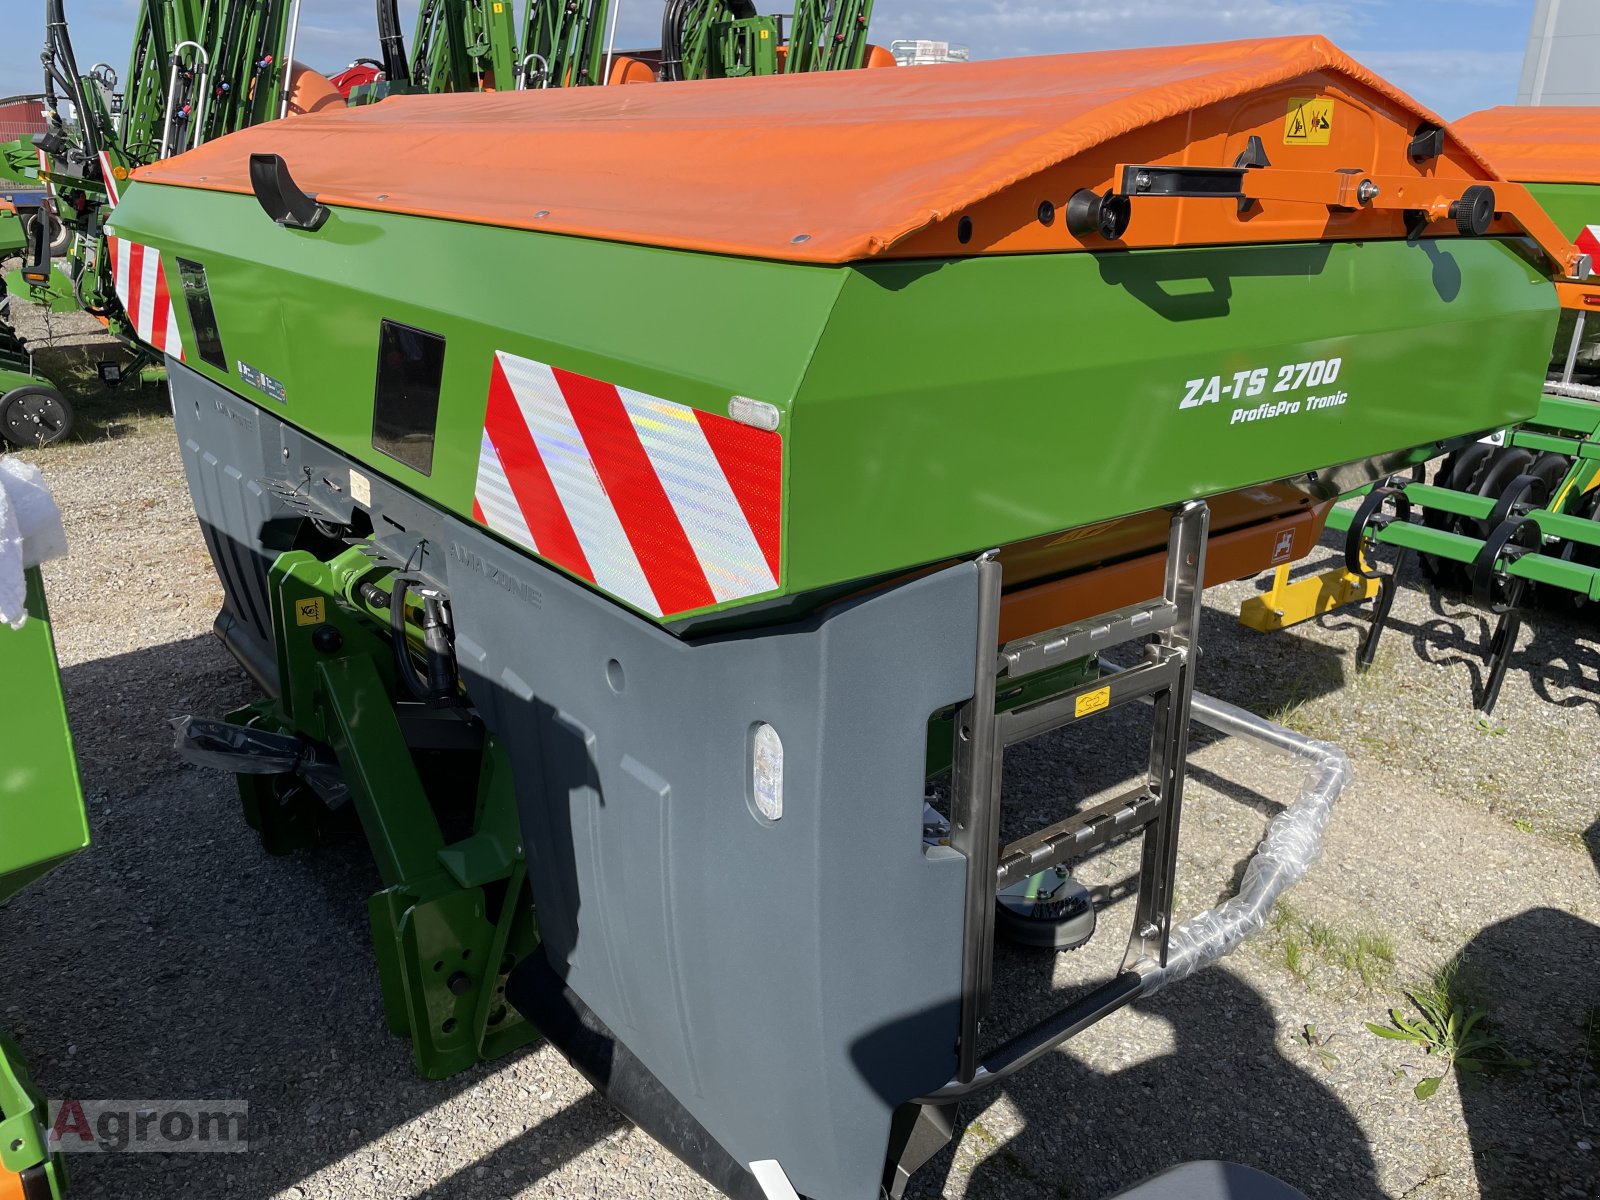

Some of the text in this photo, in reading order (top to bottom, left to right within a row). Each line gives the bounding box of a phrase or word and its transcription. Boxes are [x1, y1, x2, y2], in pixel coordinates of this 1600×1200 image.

[1179, 357, 1342, 410] ZA-TS 2700
[1230, 390, 1348, 425] ProfisPro Tronic
[449, 541, 543, 610] AMAZONE
